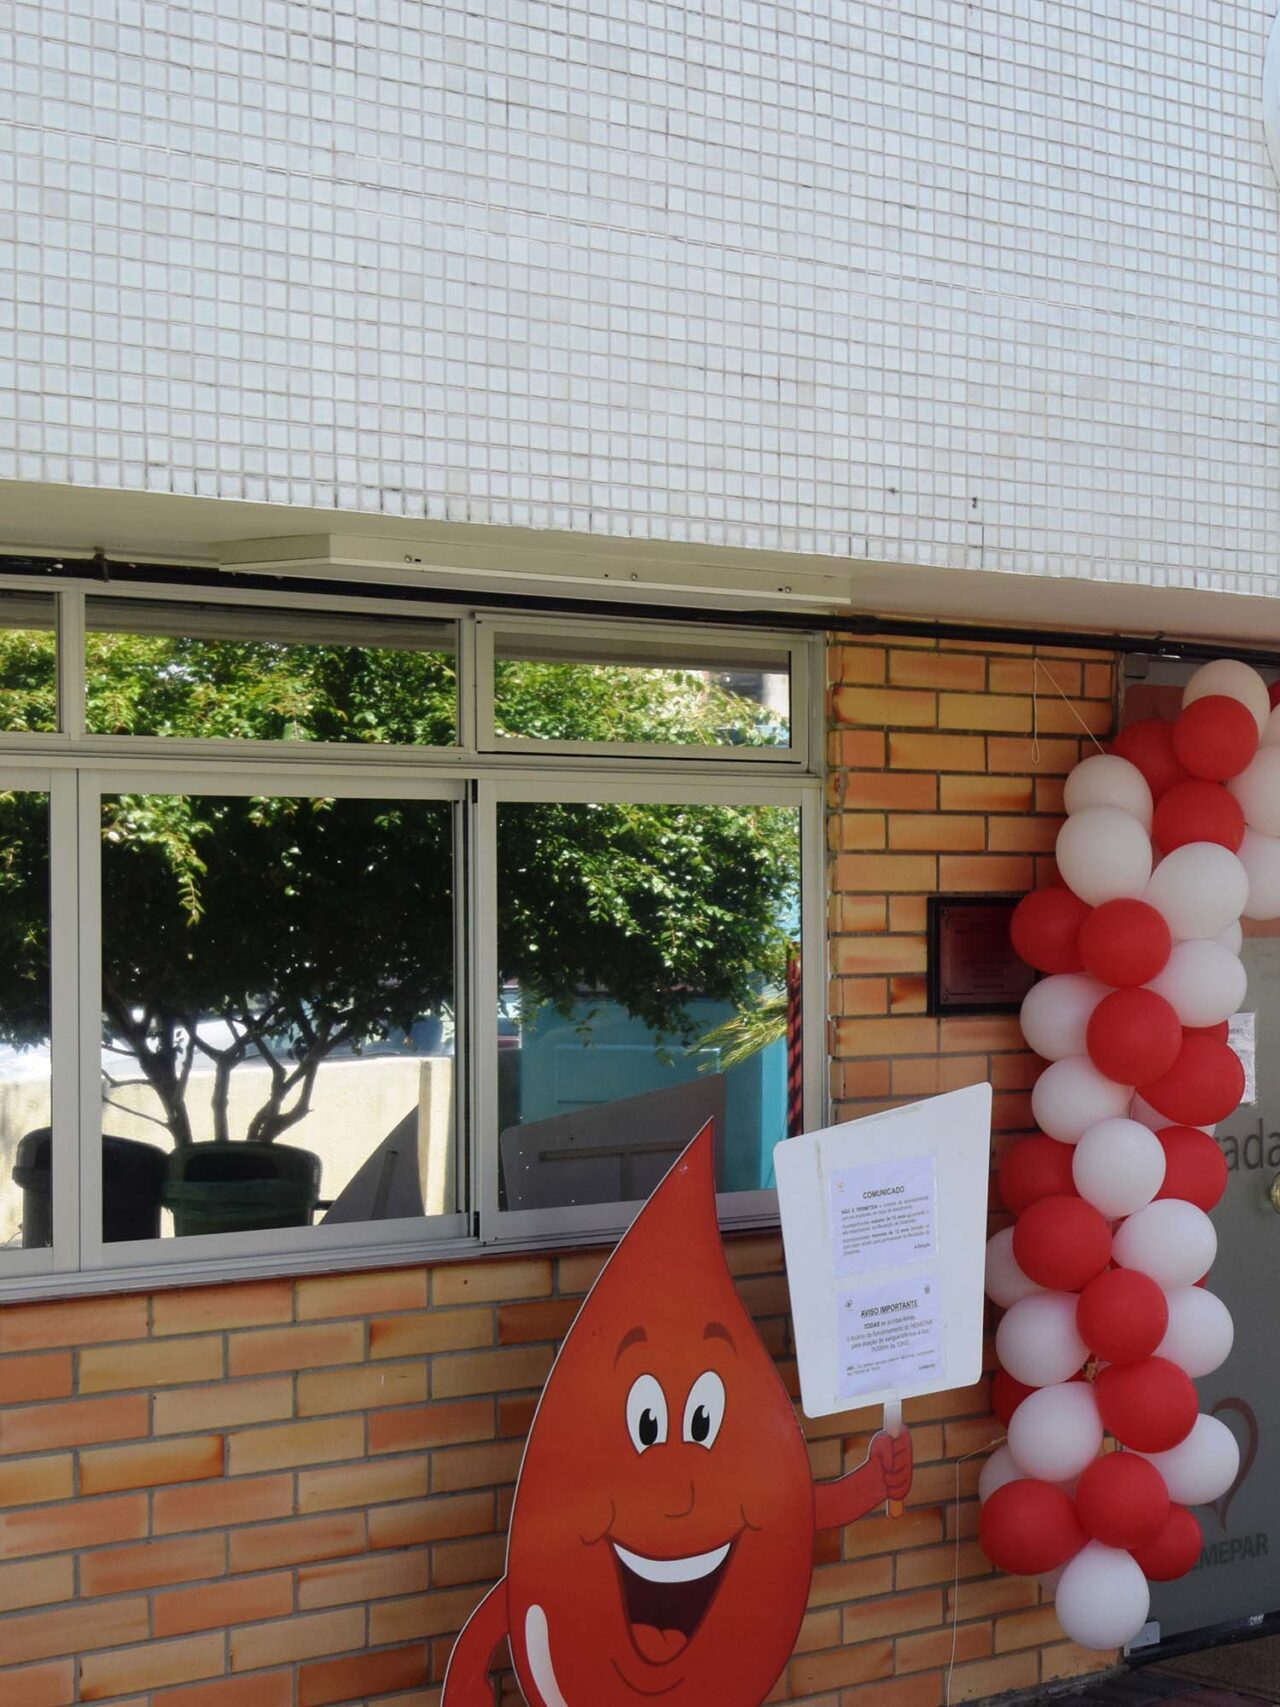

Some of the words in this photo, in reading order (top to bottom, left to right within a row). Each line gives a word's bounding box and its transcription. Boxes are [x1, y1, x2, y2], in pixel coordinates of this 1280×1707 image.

[862, 1185, 905, 1200] COMUNICADO
[860, 1307, 880, 1318] AVISO
[879, 1299, 919, 1315] IMPORTANTE
[1194, 1532, 1269, 1570] MEPAR
